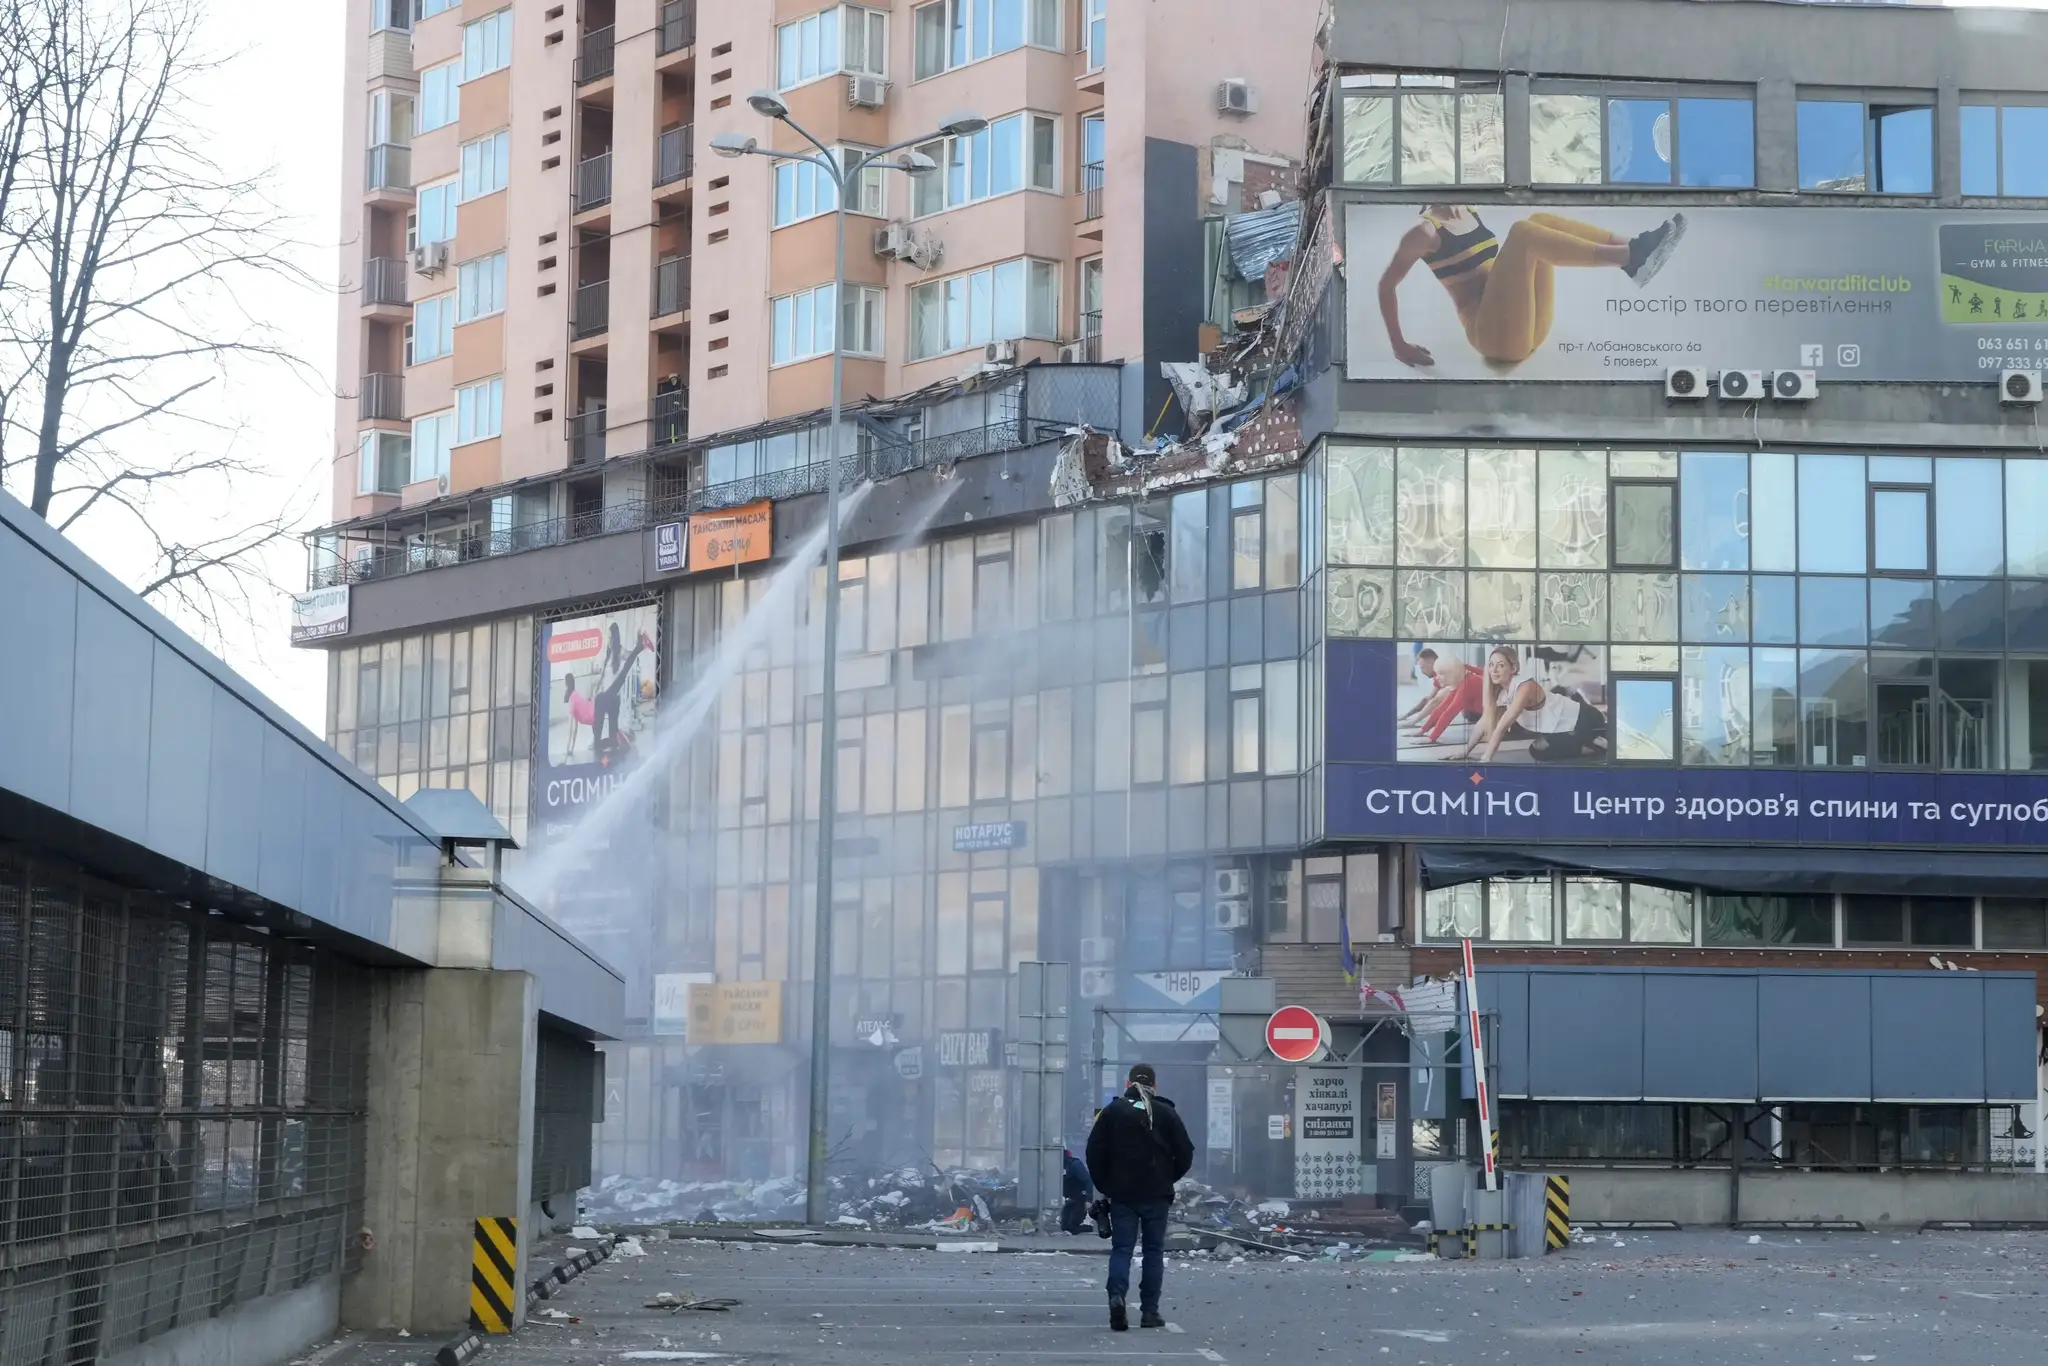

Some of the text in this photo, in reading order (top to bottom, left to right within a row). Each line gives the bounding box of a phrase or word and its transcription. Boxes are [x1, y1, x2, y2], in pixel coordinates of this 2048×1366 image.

[1970, 260, 1996, 269] GYM
[2000, 260, 2008, 268] &
[1606, 296, 1892, 317] простір твого перевтілення
[1558, 341, 1702, 353] пр-т Лобановського 6а
[1978, 338, 2002, 350] 063
[2006, 338, 2029, 350] 651
[1603, 356, 1658, 369] 5 поверх
[1978, 357, 2002, 369] 097
[2006, 357, 2031, 369] 333
[735, 511, 767, 527] МАСАЖ
[659, 555, 679, 566] YARA
[1573, 791, 1665, 821] Центр
[1809, 798, 1898, 820] спини
[1908, 800, 1941, 820] та
[955, 822, 1012, 840] НОТАРІУС
[1165, 972, 1200, 996] iHelp
[940, 1032, 967, 1066] COZY
[968, 1032, 989, 1065] BAR
[1313, 1077, 1344, 1089] харчо
[1309, 1088, 1348, 1099] хінкалі
[1305, 1100, 1352, 1114] хачапурі
[1305, 1118, 1352, 1130] сніданки
